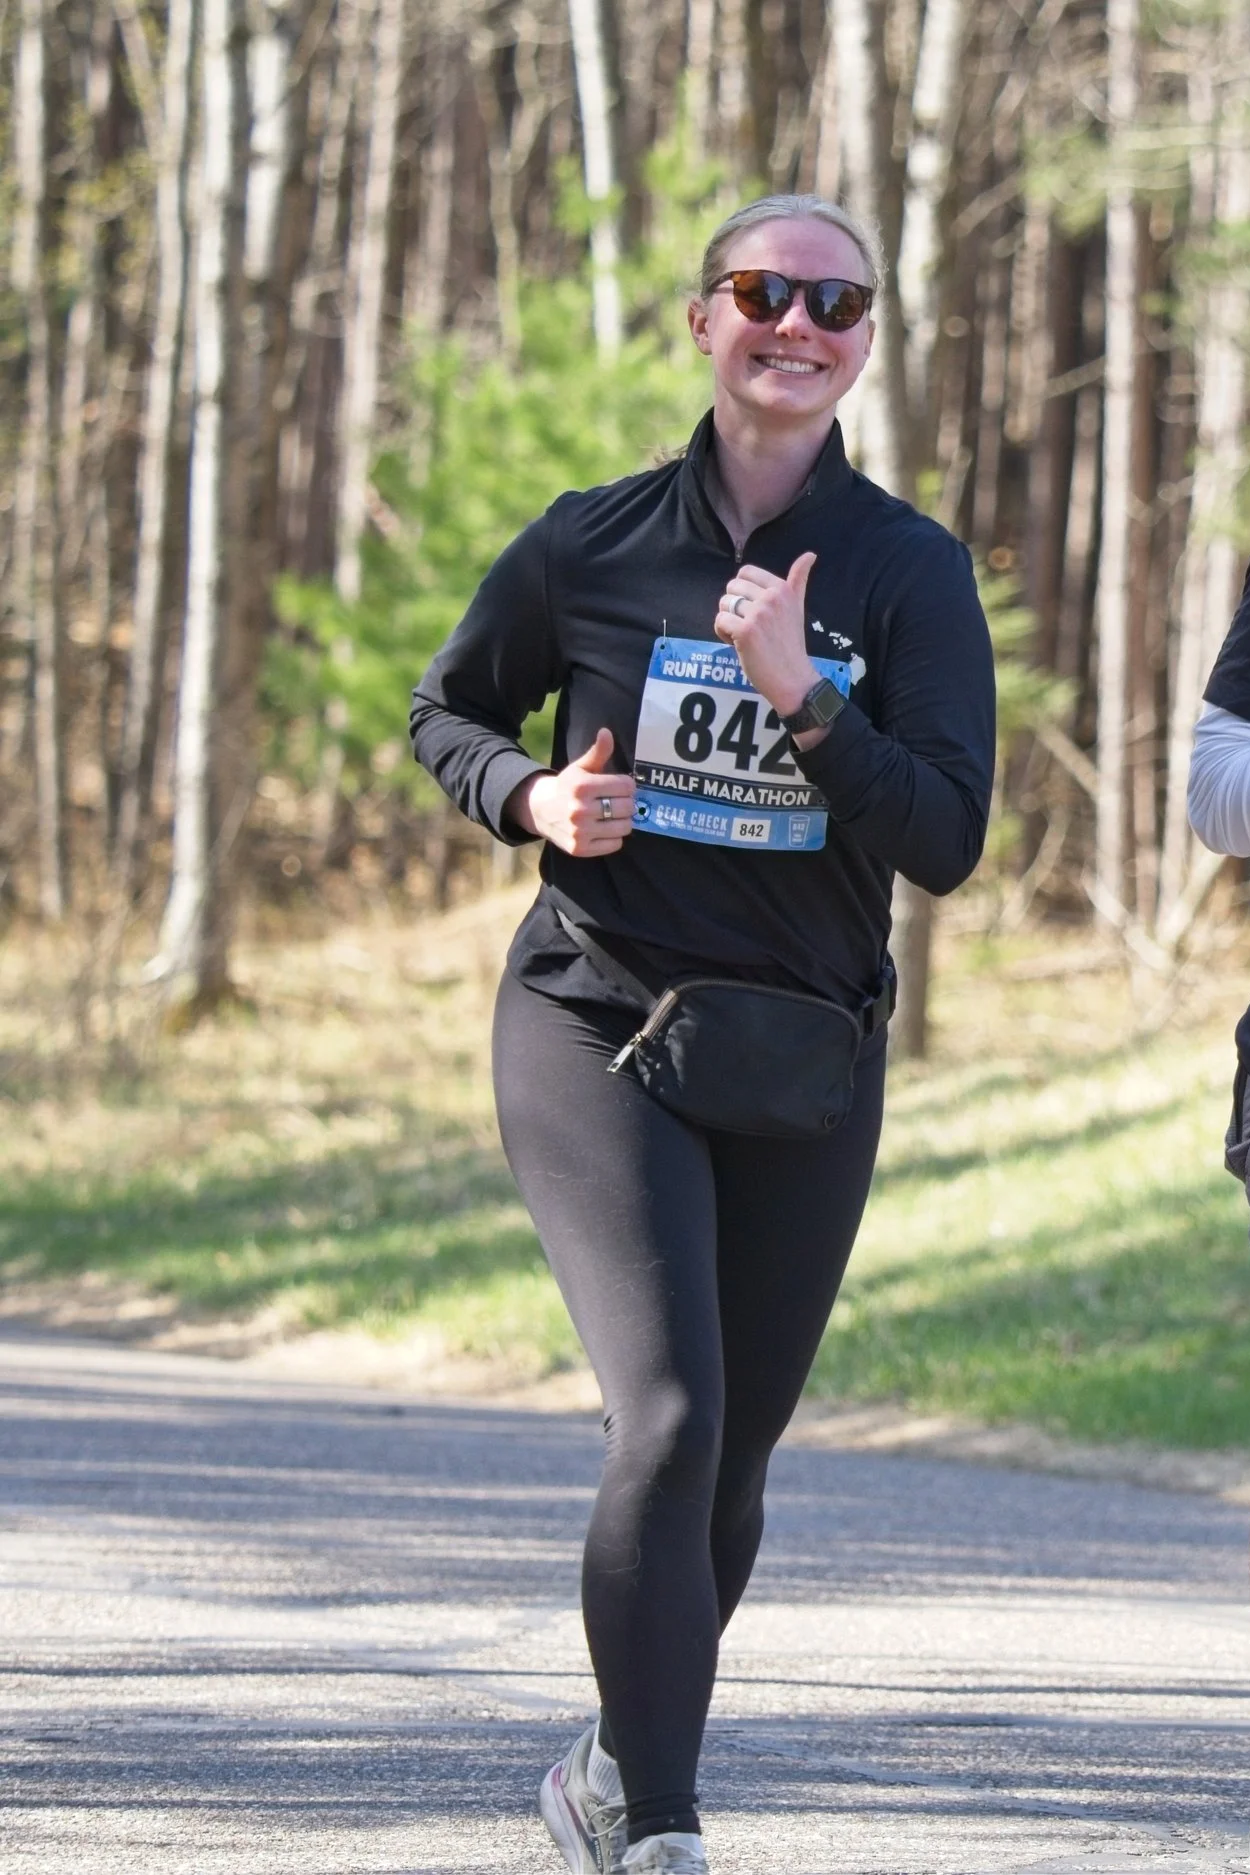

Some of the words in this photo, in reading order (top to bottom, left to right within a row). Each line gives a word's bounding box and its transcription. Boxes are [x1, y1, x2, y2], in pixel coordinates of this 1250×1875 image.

[663, 661, 698, 679] RUN
[701, 664, 736, 684] FOR
[716, 656, 741, 666] BRAI
[674, 692, 796, 776] 842
[650, 769, 699, 793] HALF
[703, 779, 811, 806] MARATHON
[655, 805, 687, 823] GEAR
[690, 811, 728, 831] CHECK
[739, 823, 764, 837] 842
